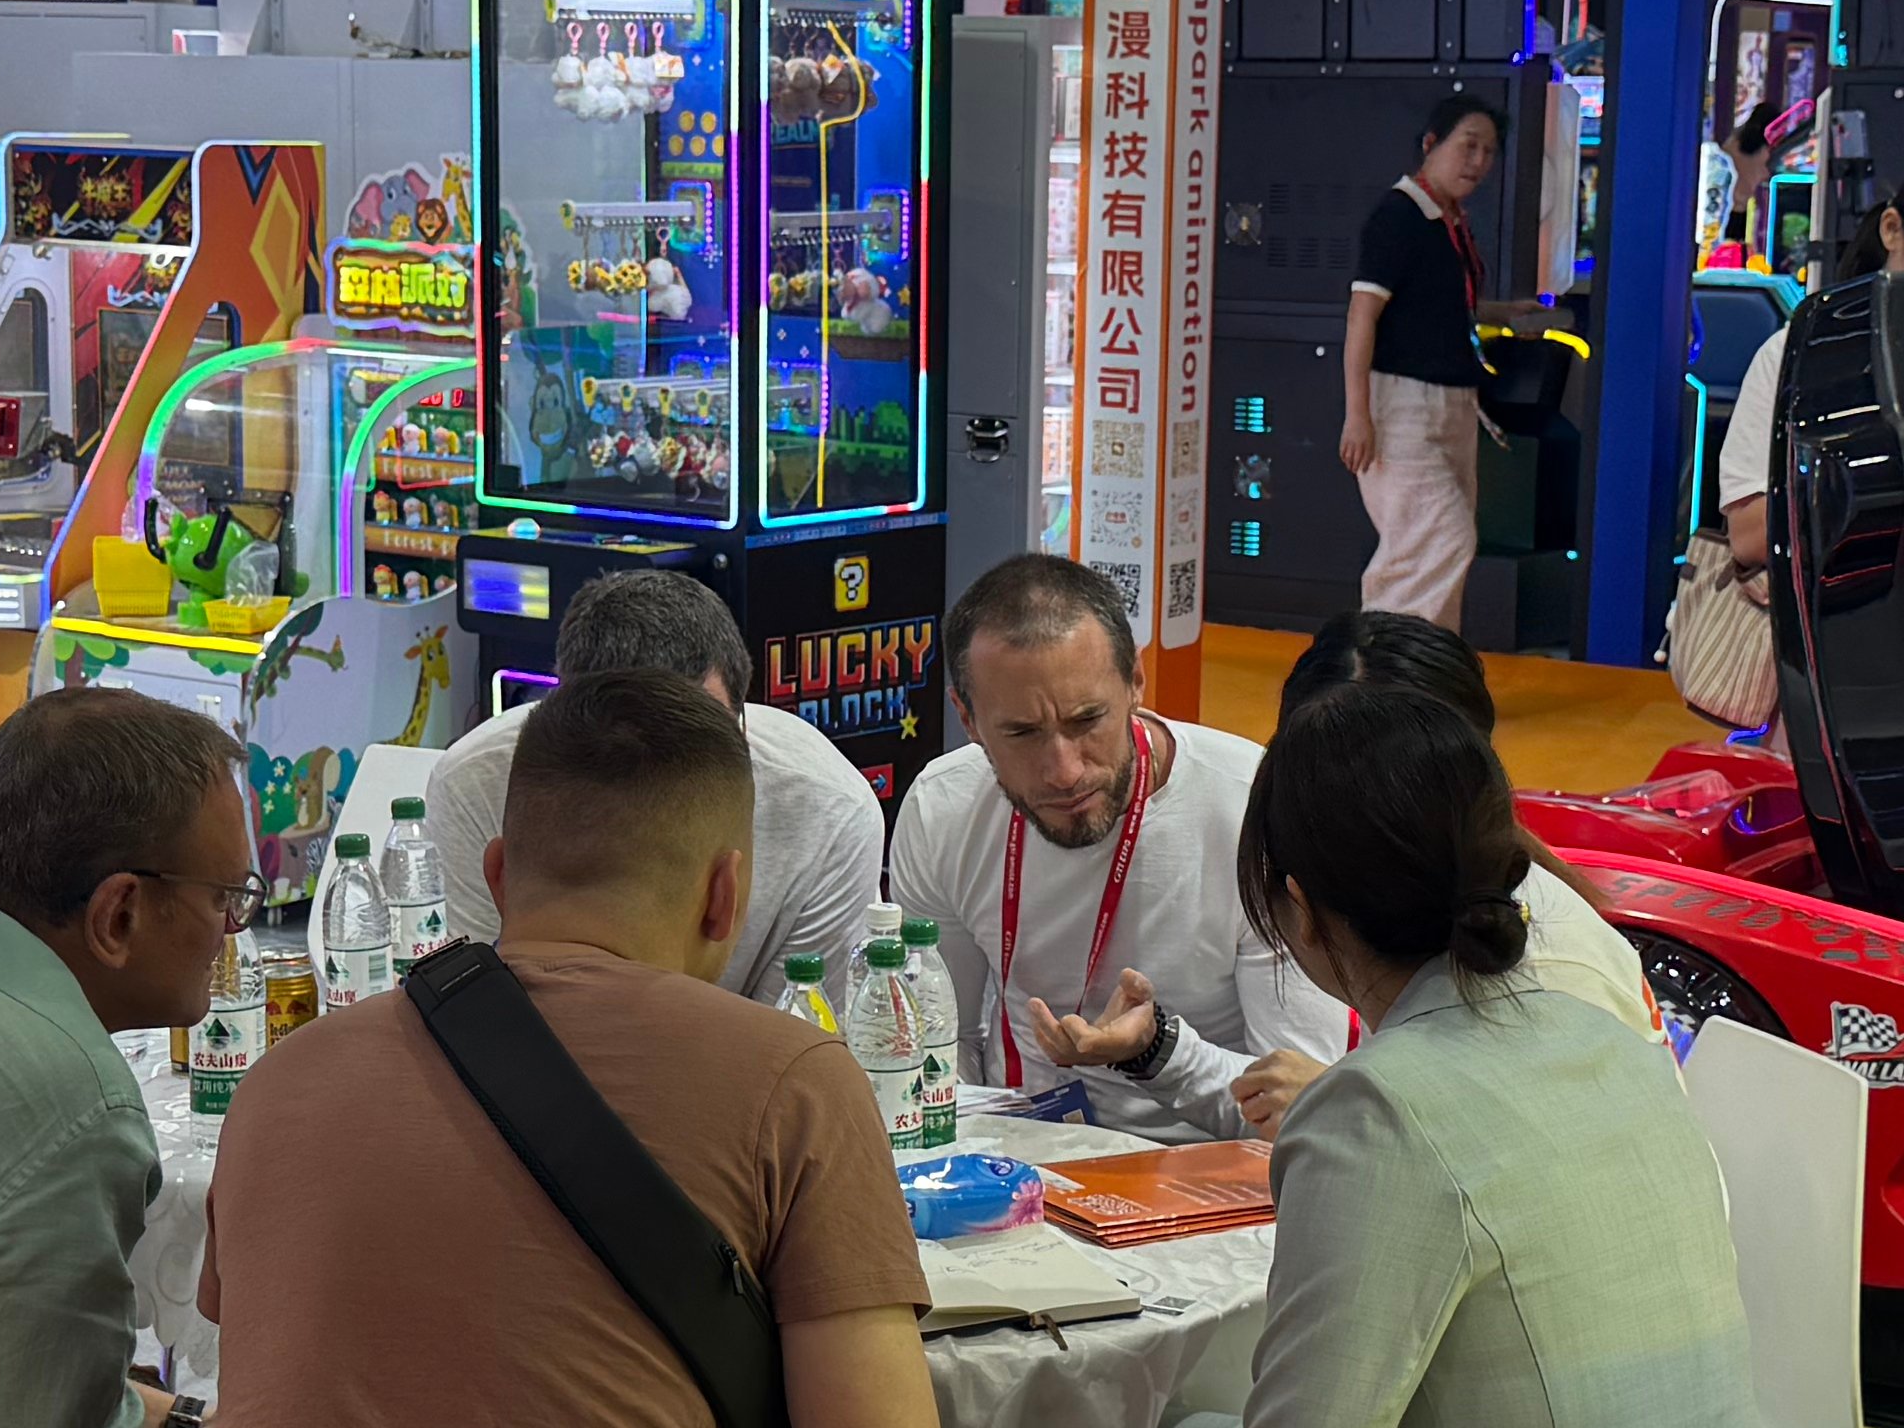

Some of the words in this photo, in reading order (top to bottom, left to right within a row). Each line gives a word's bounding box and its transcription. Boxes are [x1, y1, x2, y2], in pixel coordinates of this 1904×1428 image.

[1180, 149, 1207, 414] animation
[769, 622, 933, 698] LUCKY
[192, 1050, 248, 1069] 农夫山泉
[1846, 1059, 1884, 1081] NAL
